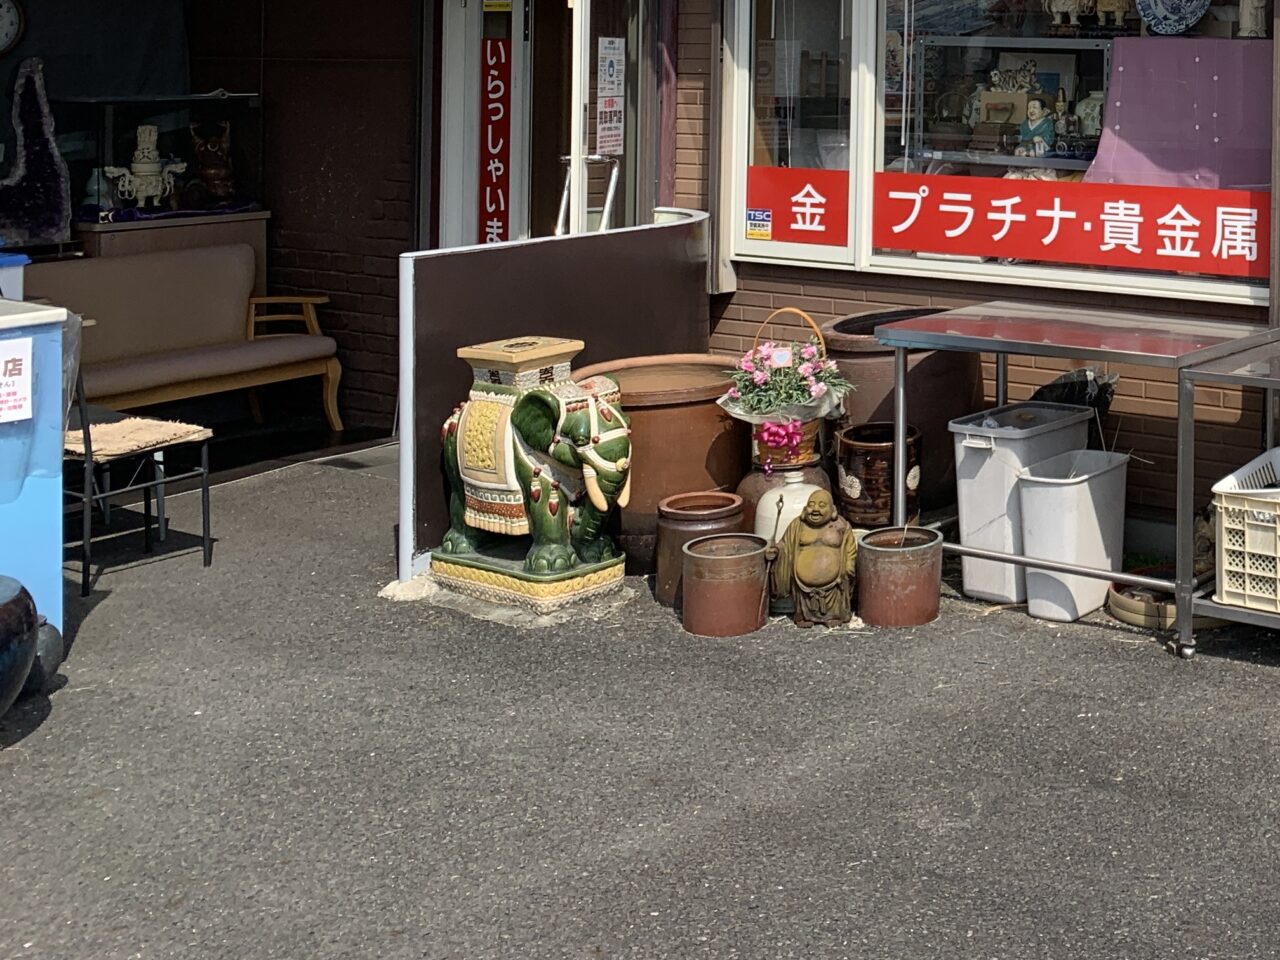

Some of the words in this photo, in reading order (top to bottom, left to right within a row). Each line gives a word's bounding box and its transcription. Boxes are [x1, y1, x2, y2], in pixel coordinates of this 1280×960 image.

[748, 211, 771, 220] TSC
[789, 183, 827, 232] 金
[887, 184, 1259, 262] プラチナ・貴金属
